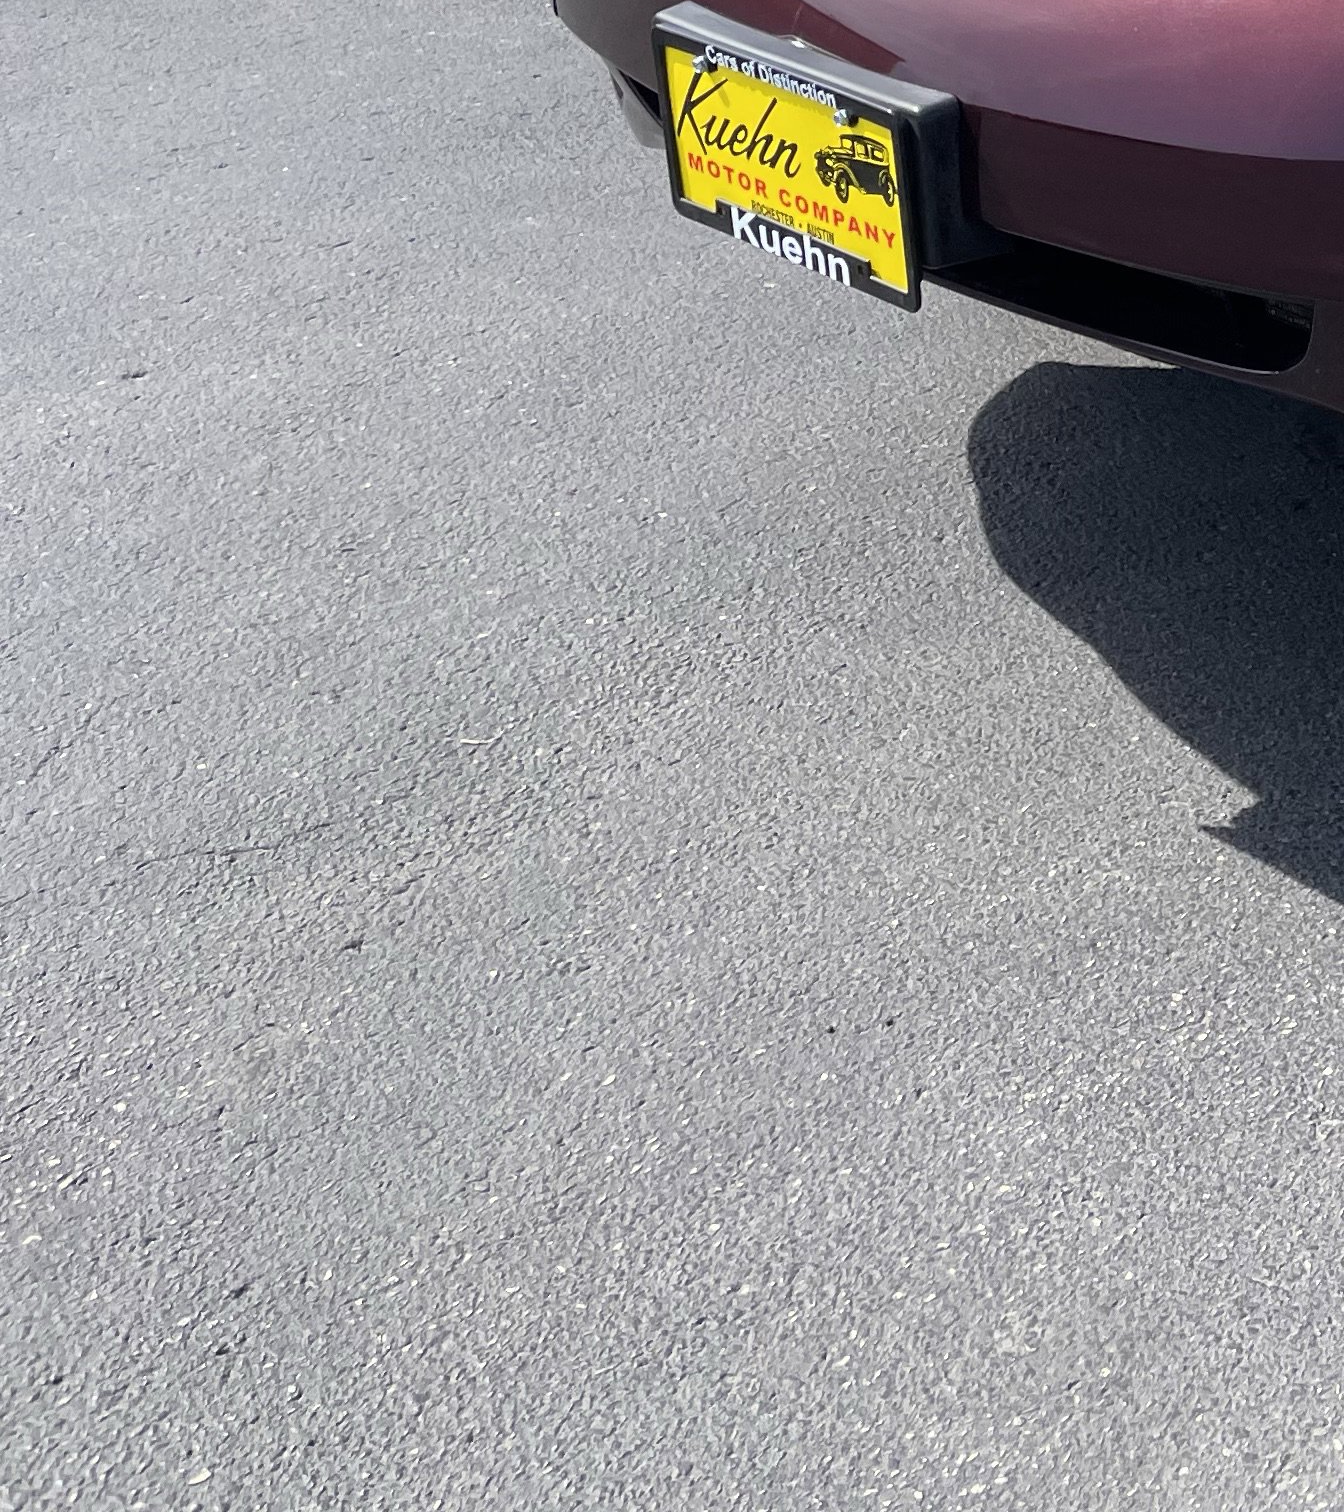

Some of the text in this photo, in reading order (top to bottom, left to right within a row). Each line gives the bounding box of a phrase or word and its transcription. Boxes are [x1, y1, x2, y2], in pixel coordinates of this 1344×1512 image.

[705, 45, 837, 109] Cars of Distinction
[677, 71, 801, 178] Kuehn
[688, 151, 897, 249] MOTOR COMPANY
[750, 199, 835, 245] ROCHESTER AUSTIN
[730, 205, 851, 287] Kuehn
